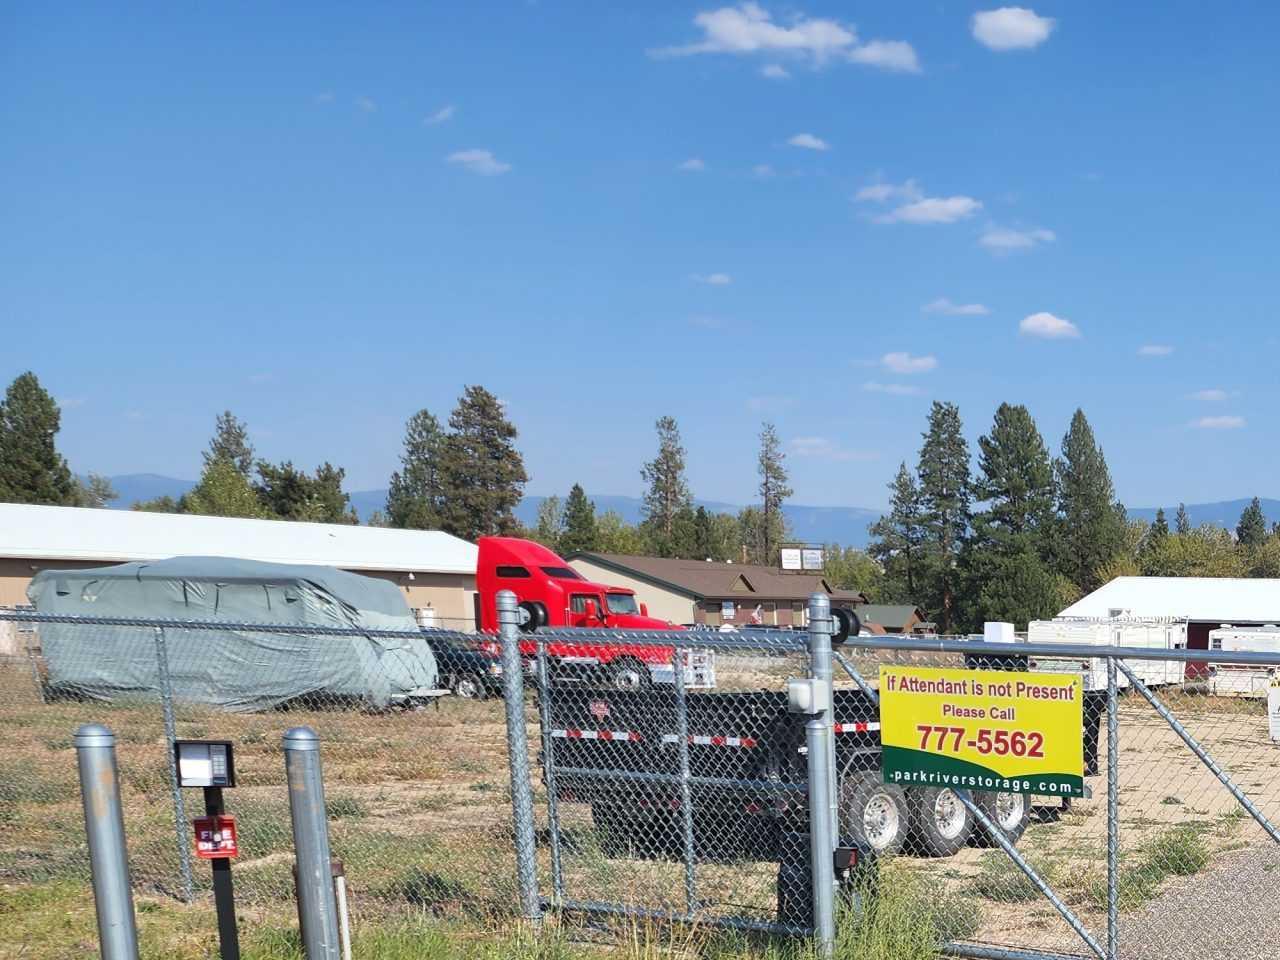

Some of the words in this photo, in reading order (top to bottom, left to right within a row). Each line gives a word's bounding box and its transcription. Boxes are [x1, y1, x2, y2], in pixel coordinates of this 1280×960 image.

[886, 675, 897, 692] If
[899, 676, 968, 695] Attendant
[971, 680, 984, 697] is
[988, 683, 1012, 698] not
[1016, 682, 1074, 700] Present
[943, 704, 986, 719] Please
[989, 706, 1015, 721] Call
[916, 725, 1045, 758] 777-5562
[200, 829, 232, 841] FIE
